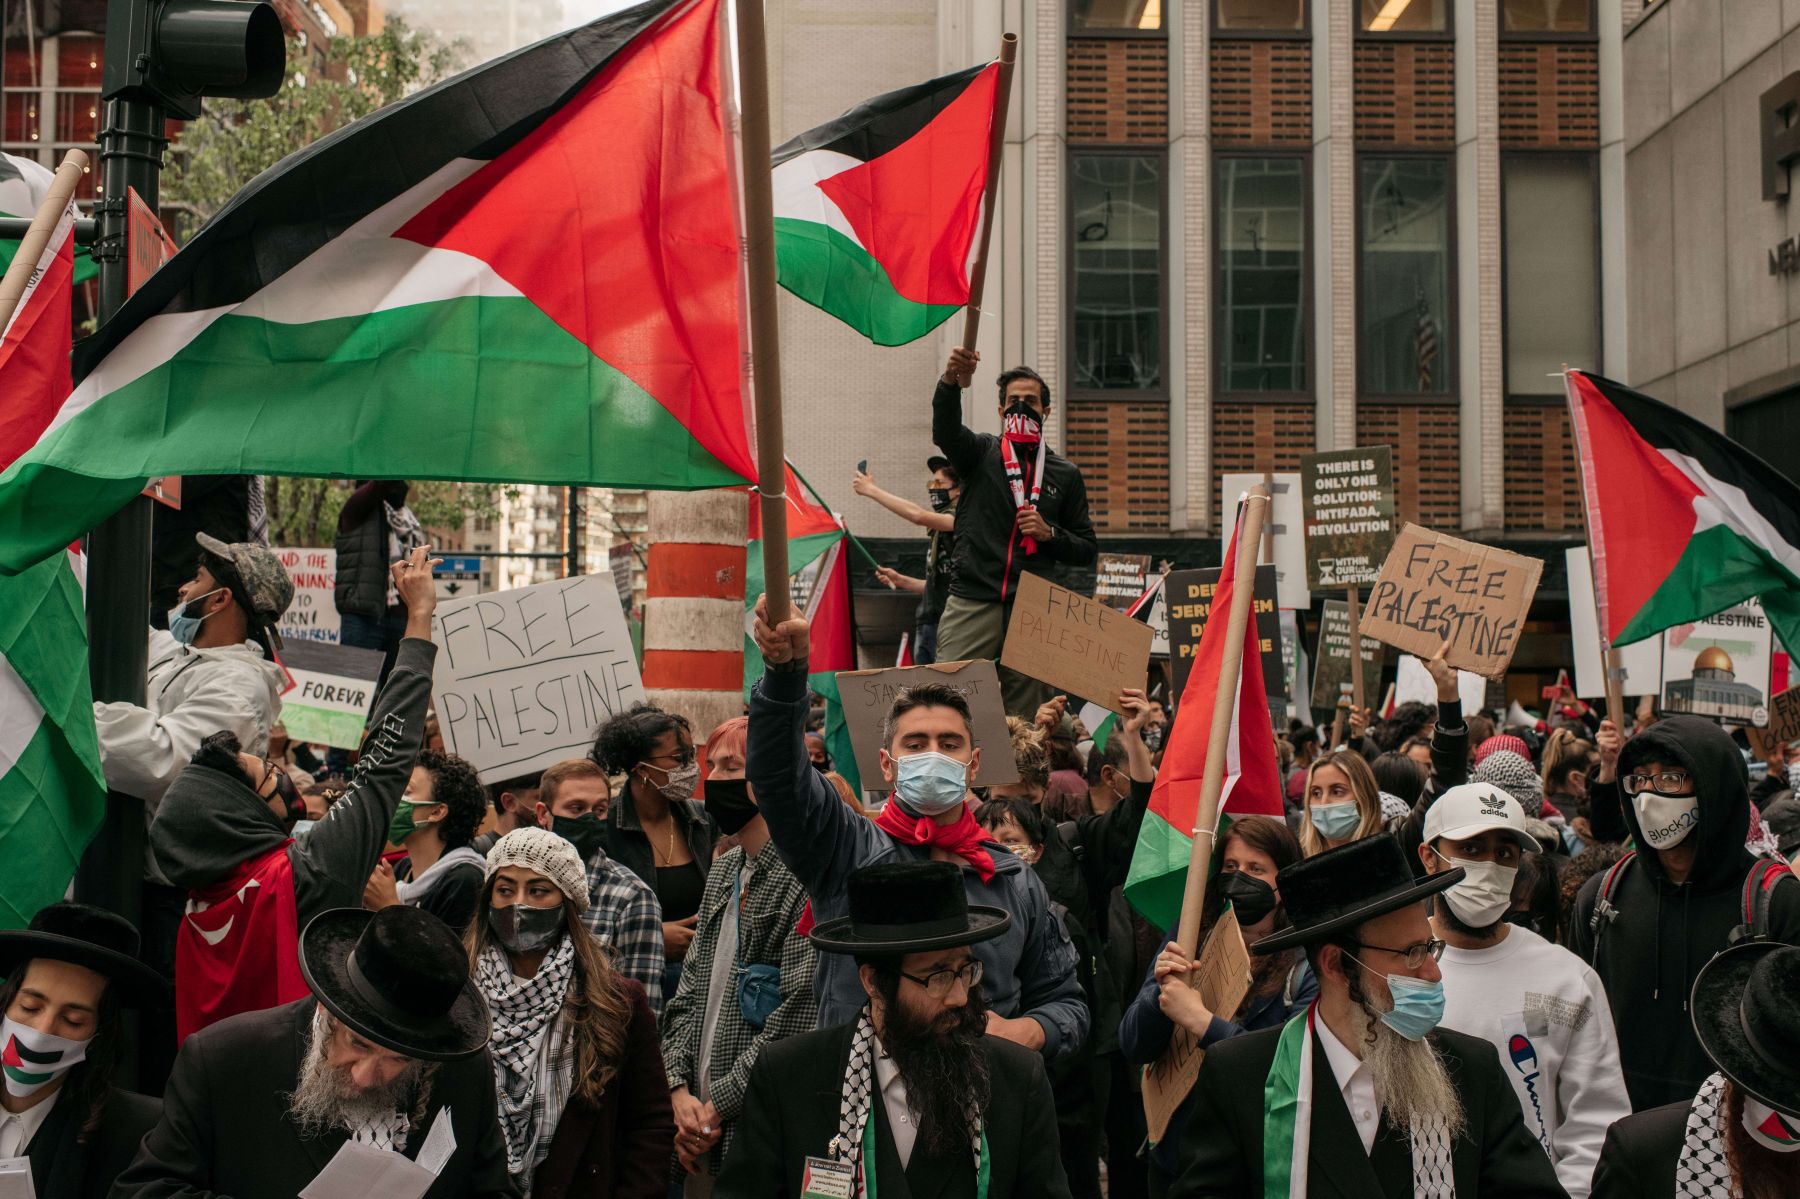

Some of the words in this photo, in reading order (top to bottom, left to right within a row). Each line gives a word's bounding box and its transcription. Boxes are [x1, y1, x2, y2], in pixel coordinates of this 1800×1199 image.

[1317, 460, 1359, 474] THERE
[1360, 459, 1374, 471] IS
[1315, 476, 1349, 489] ONLY
[1351, 474, 1378, 486] ONE
[1313, 490, 1381, 505] SOLUTION:
[1316, 506, 1380, 520] INTIFADA,
[1308, 520, 1390, 536] REVOLUTION
[306, 553, 328, 570] THE
[1104, 563, 1141, 574] SUPPORT
[1335, 556, 1369, 566] WITHIN
[1335, 566, 1355, 575] OUR
[1405, 543, 1507, 600] FREE
[1096, 574, 1145, 586] PALESTINIAN
[1096, 586, 1143, 598] RESISTANCE
[297, 593, 312, 608] TO
[1047, 585, 1112, 632] FREE
[1325, 609, 1339, 619] WE
[441, 579, 605, 669] FREE
[1701, 613, 1765, 628] ALESTINE
[1019, 610, 1129, 674] PALESTINE
[1361, 638, 1380, 649] OUR
[302, 681, 366, 708] FOREVR
[1480, 809, 1509, 819] adidas
